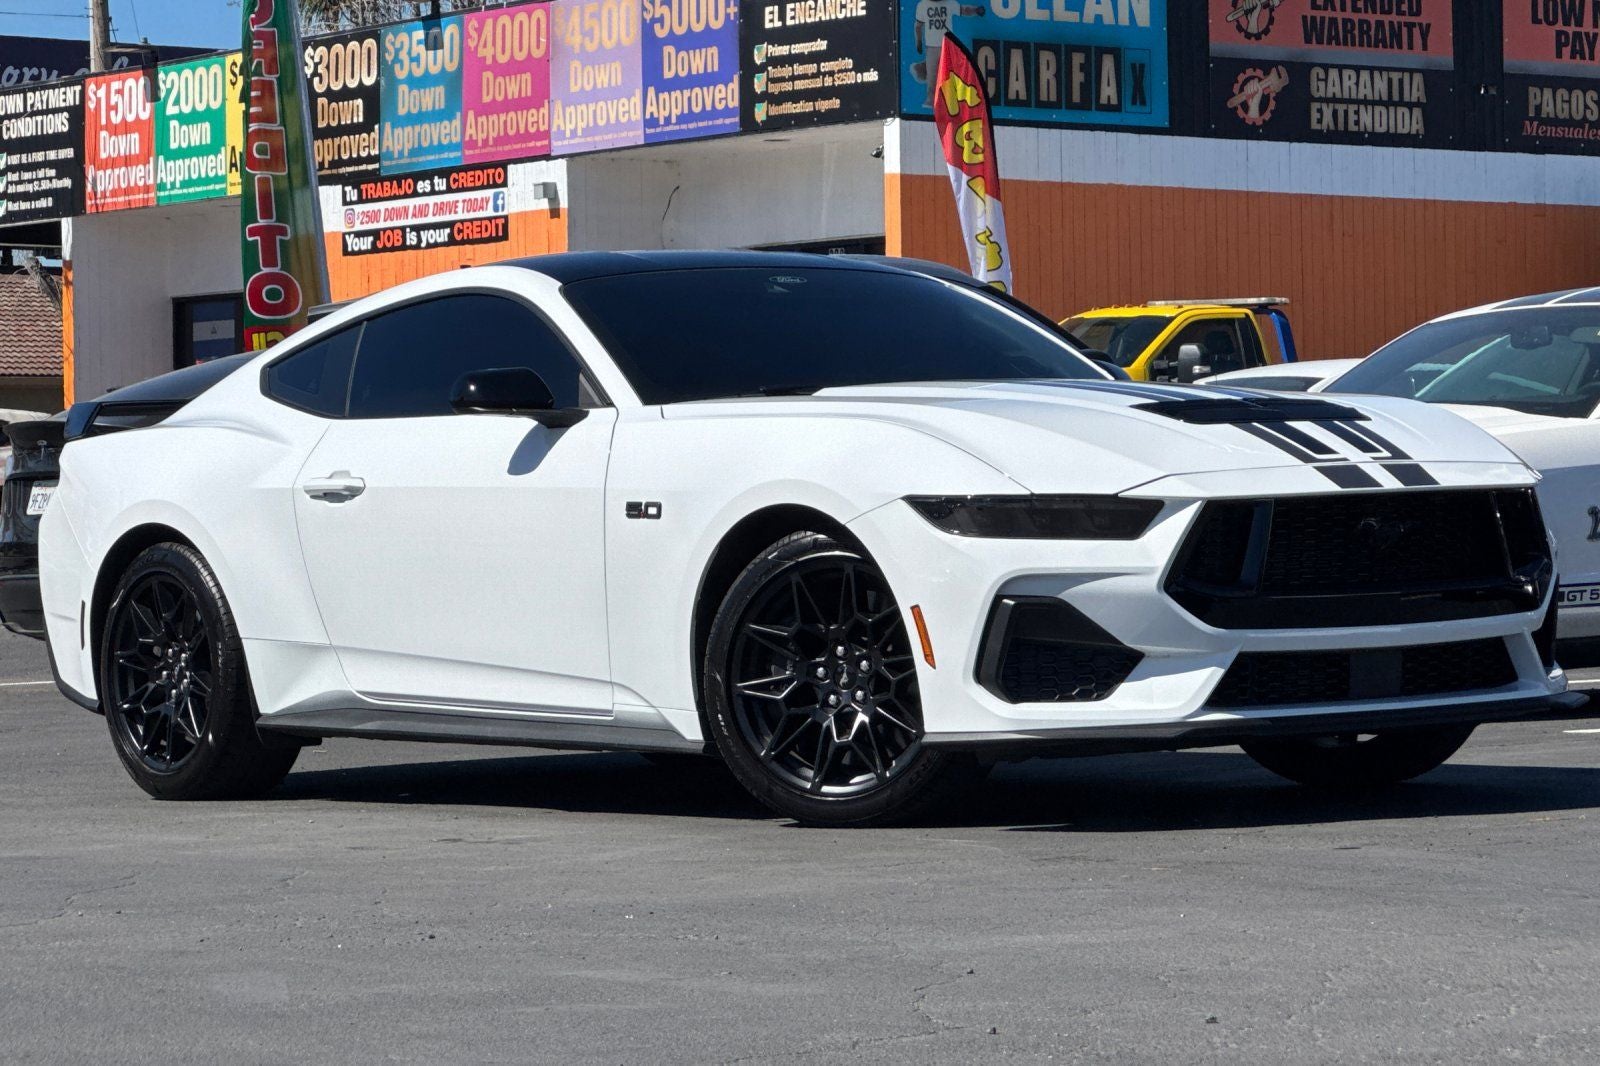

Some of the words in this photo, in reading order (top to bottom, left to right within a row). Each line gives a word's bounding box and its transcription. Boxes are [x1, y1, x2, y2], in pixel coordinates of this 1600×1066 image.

[554, 0, 638, 54] $4500
[764, 5, 782, 29] EL
[785, 0, 867, 26] ENGANCHE
[926, 7, 948, 18] CAR
[928, 19, 948, 30] FOX
[1531, 0, 1585, 27] LOW
[468, 9, 547, 65] $4000
[767, 43, 790, 57] Primer
[1301, 15, 1431, 51] WARRANTY
[1555, 29, 1599, 61] PAY
[304, 38, 378, 93] $3000
[385, 23, 460, 80] $3500
[663, 45, 719, 79] Down
[482, 70, 532, 103] Down
[569, 59, 622, 93] Down
[767, 64, 792, 79] Trabajo
[975, 46, 1146, 106] CARFAX
[1310, 66, 1427, 103] GARANTIA
[27, 85, 81, 112] PAYMENT
[88, 76, 151, 126] $1500
[158, 64, 222, 115] $2000
[397, 85, 445, 116] Down
[645, 74, 739, 126] Approved
[1528, 86, 1599, 121] PAGOS
[2, 112, 69, 140] CONDITIONS
[317, 96, 364, 128] Down
[465, 99, 549, 147] Approved
[553, 88, 641, 138] Approved
[1310, 101, 1425, 135] EXTENDIDA
[100, 130, 140, 159] Down
[169, 120, 211, 149] Down
[314, 124, 379, 169] pproved
[382, 112, 461, 158] Approved
[87, 157, 154, 198] Approved
[157, 147, 226, 189] Approved
[344, 185, 358, 201] Tu
[360, 179, 414, 200] TRABAJO
[416, 181, 431, 193] es
[434, 176, 447, 190] tu
[450, 167, 505, 189] CREDITO
[356, 211, 381, 226] $2500
[383, 208, 409, 222] DOWN
[411, 205, 430, 219] AND
[432, 201, 459, 216] DRIVE
[461, 196, 490, 213] TODAY
[345, 231, 374, 252] Your
[376, 229, 403, 248] JOB
[405, 227, 418, 246] is
[420, 225, 450, 248] your
[453, 218, 505, 240] CREDIT
[1566, 590, 1587, 602] GT
